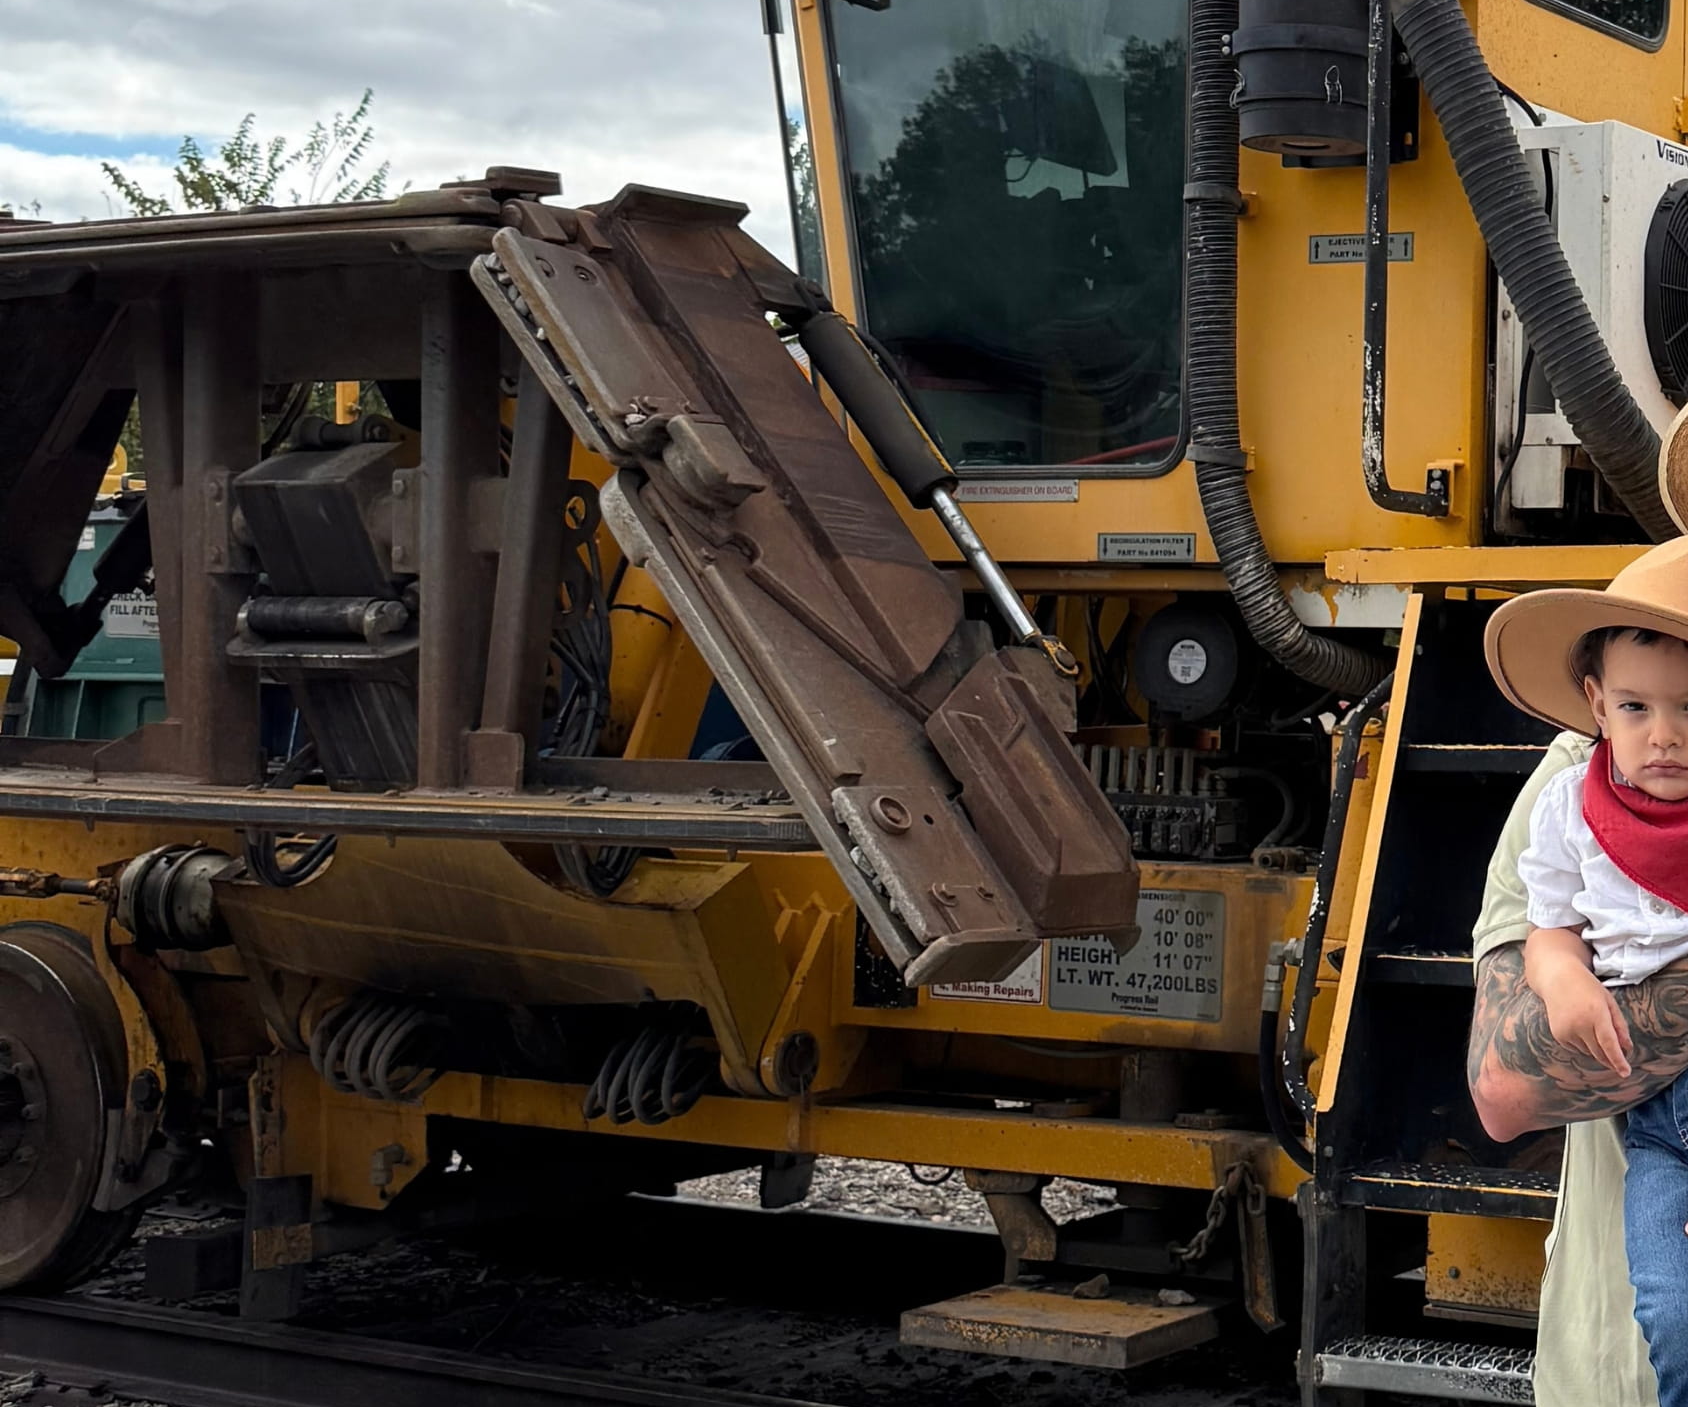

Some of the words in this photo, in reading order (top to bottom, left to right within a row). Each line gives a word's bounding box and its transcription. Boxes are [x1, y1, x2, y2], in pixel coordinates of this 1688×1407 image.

[980, 486, 1033, 494] EXTINGUISHER
[1034, 486, 1045, 494] ON
[1047, 486, 1072, 494] BOARD
[110, 605, 129, 615] FILL
[132, 606, 157, 616] AFTE
[1154, 908, 1179, 925] 40'
[1184, 910, 1214, 926] 00"
[1154, 931, 1178, 947] 10'
[1184, 932, 1213, 949] 08"
[1057, 946, 1121, 965] HEIGHT
[1154, 952, 1177, 969] 11'
[1183, 955, 1212, 970] 07"
[1057, 968, 1082, 984] LT.
[1088, 969, 1119, 987] WT.
[1126, 973, 1218, 994] 47,200LBS
[952, 983, 990, 995] Making
[994, 984, 1034, 997] Repairs
[1111, 993, 1143, 1005] Progress
[1145, 995, 1159, 1005] Rail
